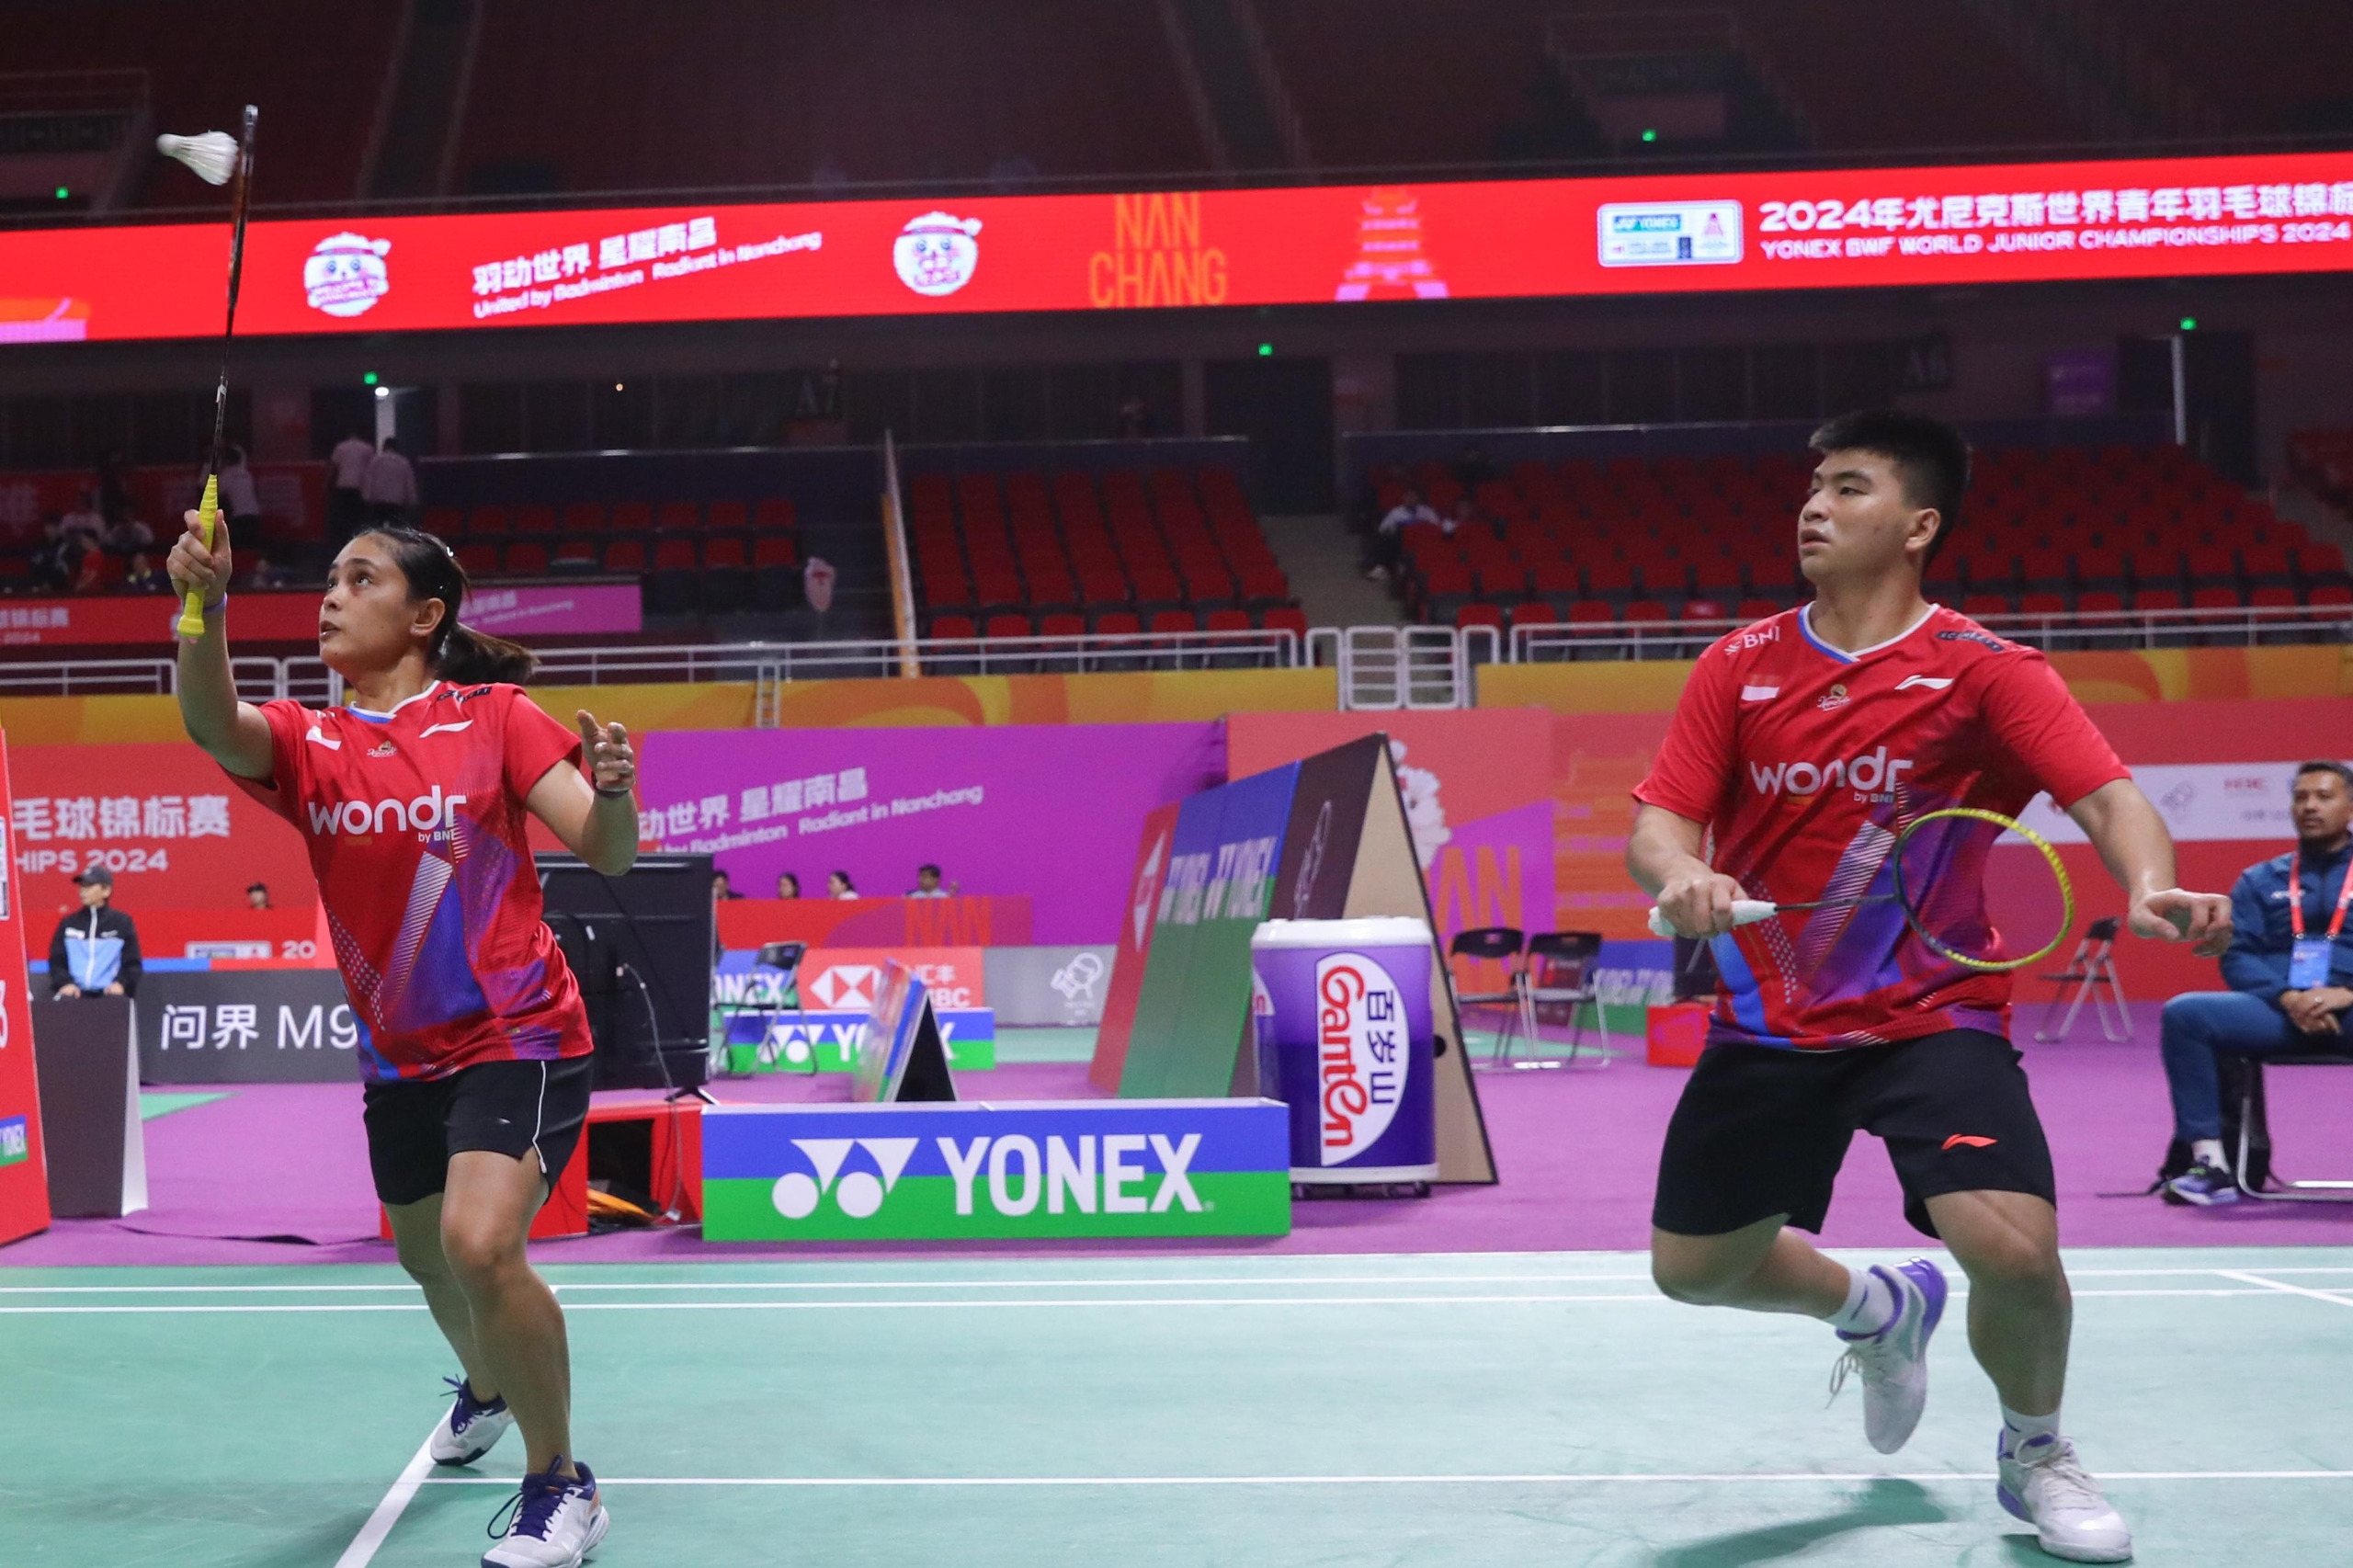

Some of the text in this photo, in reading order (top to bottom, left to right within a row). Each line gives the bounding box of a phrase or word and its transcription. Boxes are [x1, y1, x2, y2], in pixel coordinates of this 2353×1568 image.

[1114, 191, 1200, 248] NAN
[1759, 222, 2351, 260] YONEX BWF WORLD JUNIOR CHAMPIONSHIPS 2024
[472, 215, 717, 296] 羽动世界 星耀南昌
[1087, 247, 1227, 309] CHANG
[472, 290, 530, 319] United
[530, 288, 552, 309] by
[552, 269, 644, 301] Badminton
[652, 253, 717, 280] Radiant
[717, 248, 735, 267] in
[1743, 626, 1780, 650] BNI
[1750, 745, 1914, 796] wondr
[12, 795, 231, 841] 毛球锦标赛
[308, 784, 467, 835] wondr
[798, 805, 869, 835] Radiant
[870, 802, 890, 821] in
[890, 785, 984, 816] Nanchang
[1853, 791, 1869, 804] by
[85, 847, 170, 873] 2024
[417, 831, 432, 844] by
[1430, 845, 1521, 936] AN
[281, 939, 317, 960] 20
[160, 1004, 358, 1051] 问界 M9
[1366, 990, 1396, 1105] 百岁山
[936, 1132, 1204, 1217] YONEX
